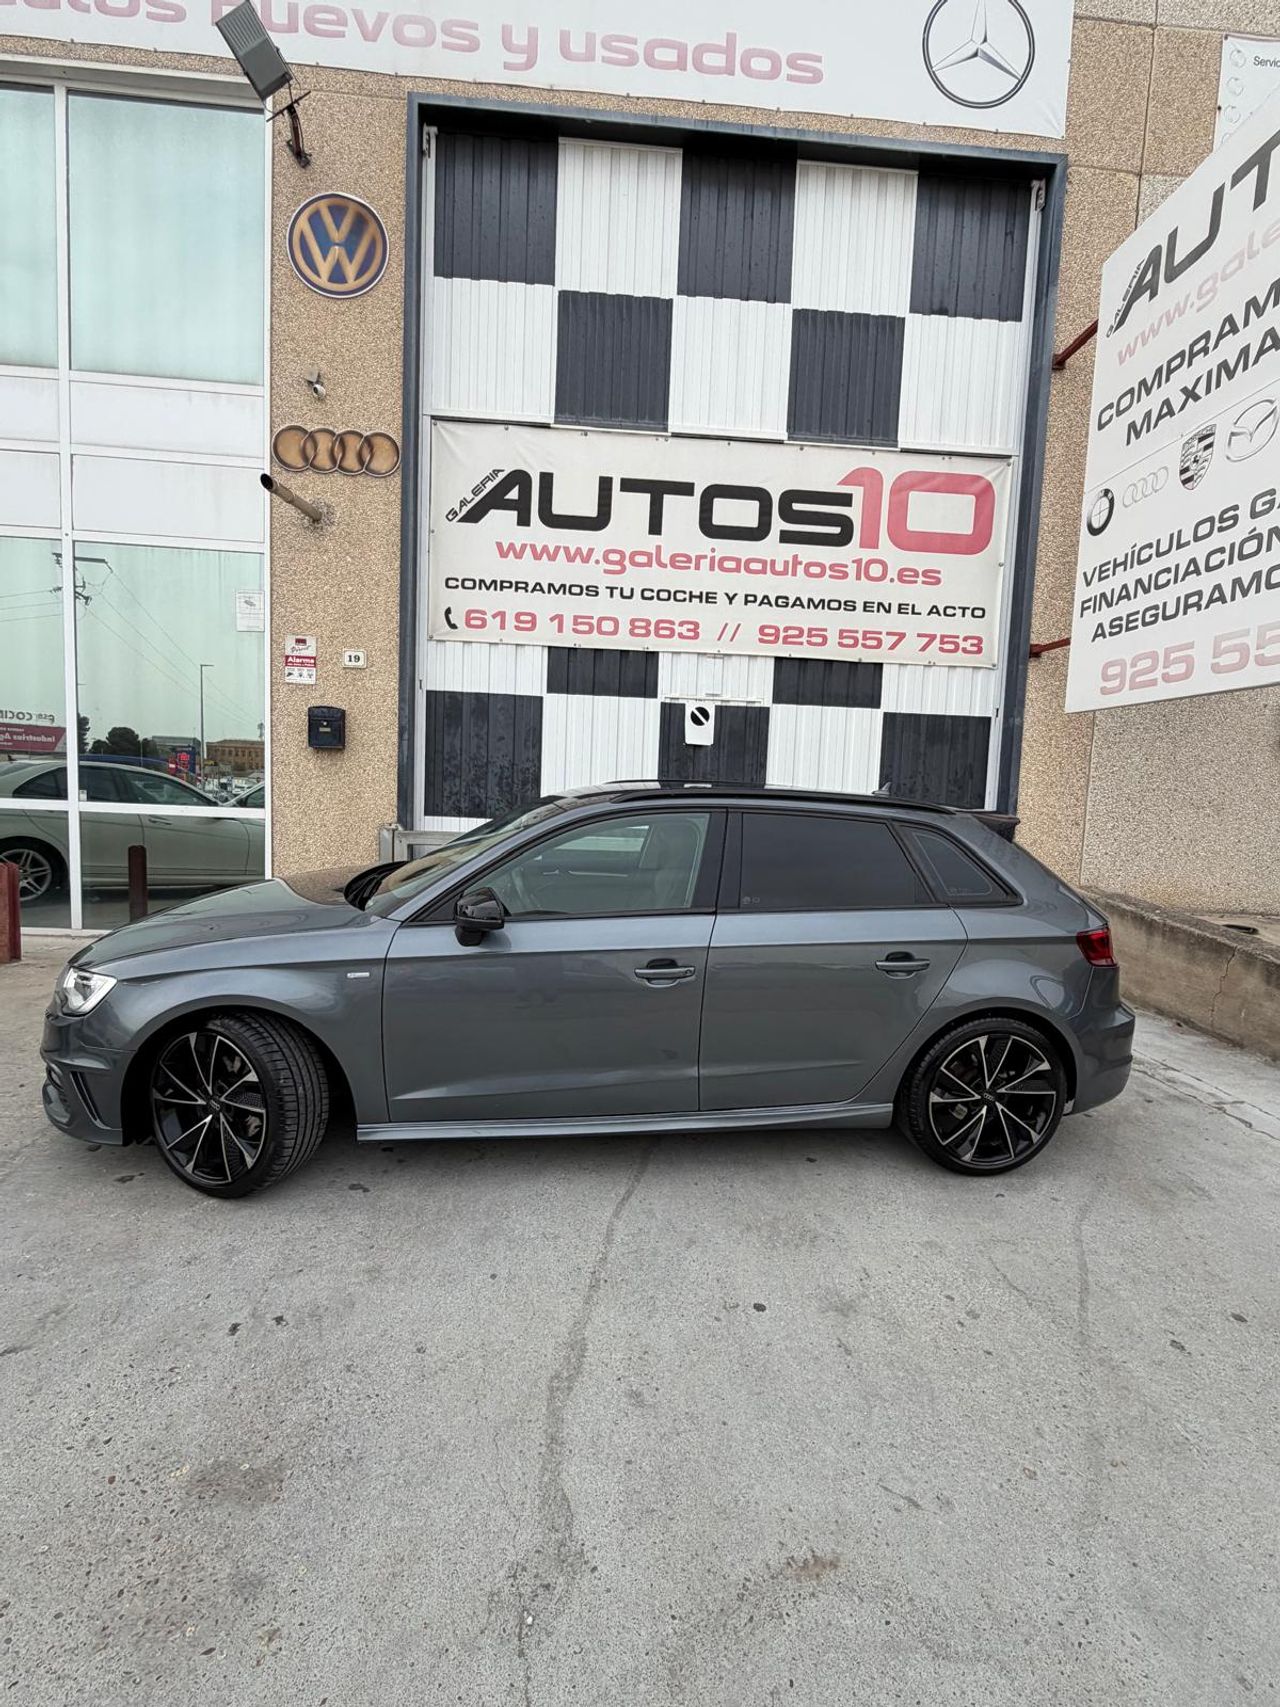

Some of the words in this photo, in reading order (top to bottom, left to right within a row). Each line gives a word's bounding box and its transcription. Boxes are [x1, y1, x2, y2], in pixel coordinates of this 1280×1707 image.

[502, 23, 538, 71] y
[559, 29, 824, 85] usados
[1098, 277, 1280, 431] COMPRAM
[1126, 327, 1280, 446] MAXIMA
[445, 468, 505, 523] GALERIA
[495, 541, 942, 586] www.galeriaautos10.es
[1083, 503, 1240, 588] VEHÍCULOS
[444, 576, 599, 597] COMPRAMOS
[605, 586, 635, 600] TU
[640, 587, 718, 605] COCHE
[724, 592, 739, 606] Y
[744, 593, 857, 612] PAGAMOS
[863, 600, 892, 614] EN
[899, 602, 922, 616] EL
[926, 604, 986, 619] ACTO
[348, 654, 361, 663] 19
[464, 608, 537, 633] 619
[549, 613, 620, 636] 150
[628, 617, 700, 641] 863
[757, 624, 828, 647] 925
[837, 628, 906, 651] 557
[916, 632, 984, 655] 753
[1100, 641, 1195, 696] 925
